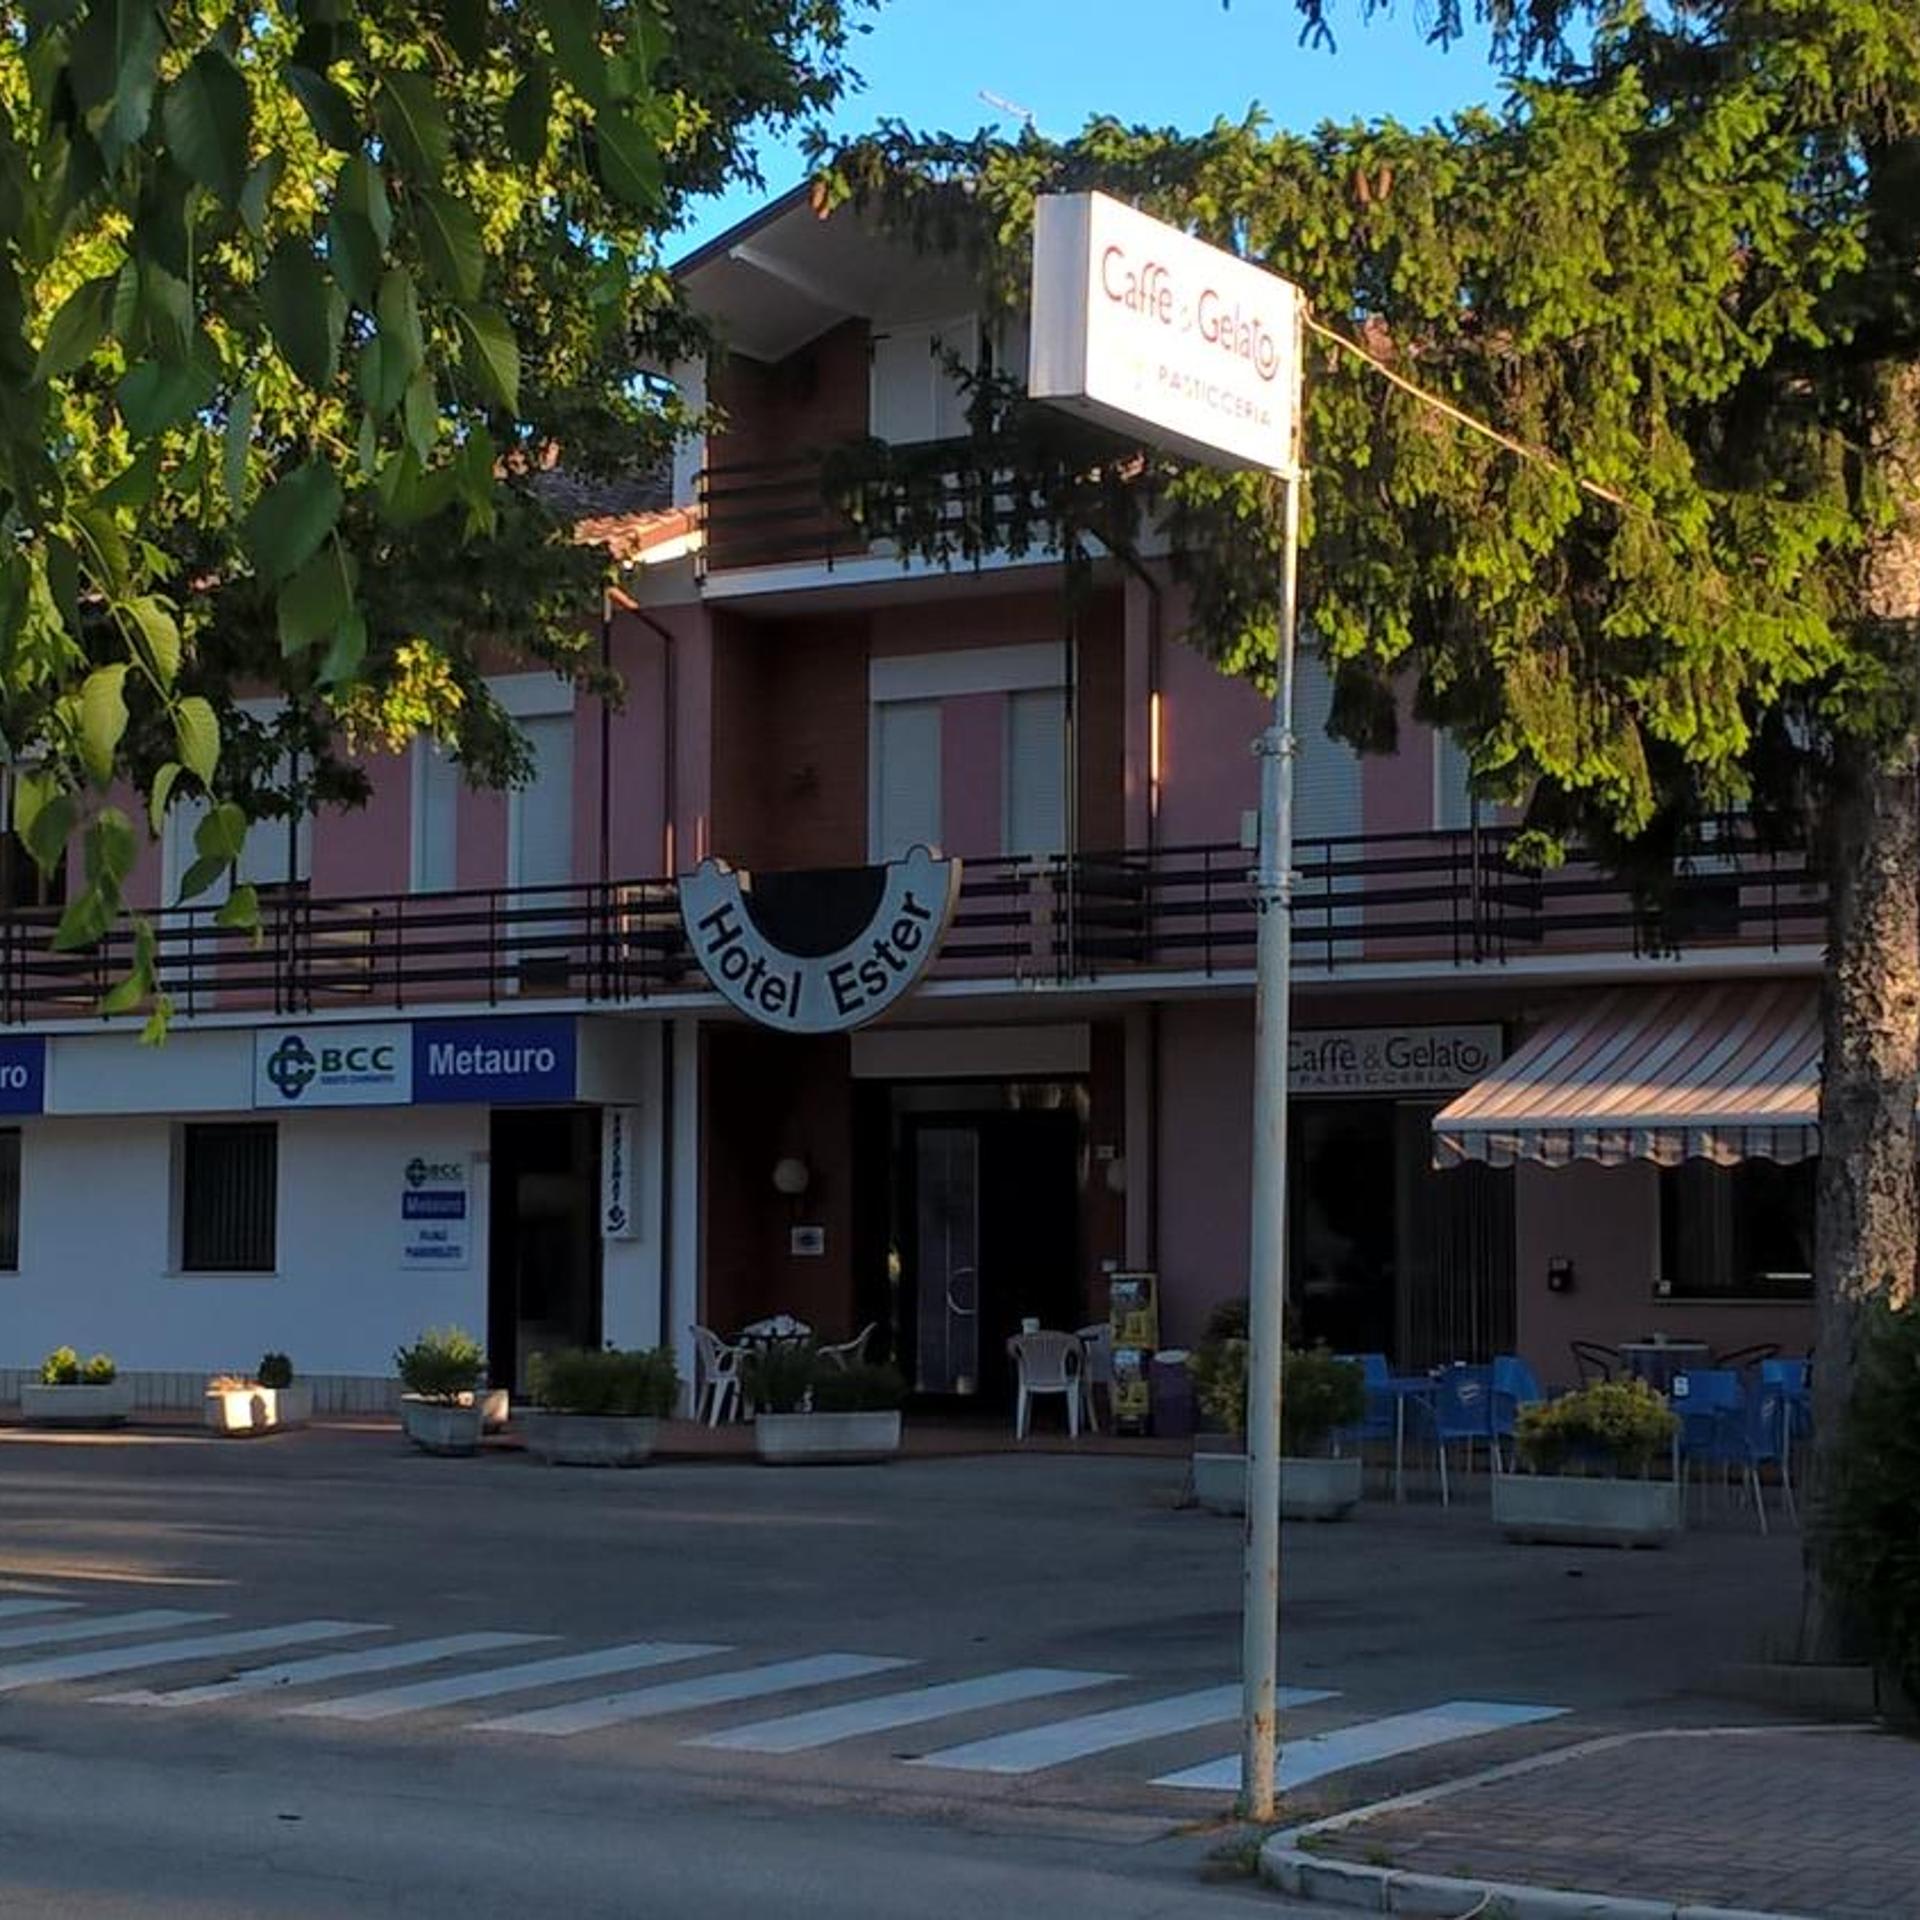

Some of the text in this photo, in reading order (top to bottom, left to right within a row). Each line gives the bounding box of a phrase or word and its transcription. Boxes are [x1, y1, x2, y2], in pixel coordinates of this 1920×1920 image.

[1199, 289, 1280, 382] Gelato
[698, 891, 932, 1018] Hotel Ester
[320, 1046, 395, 1073] BCC
[428, 1042, 556, 1077] Metauro
[1362, 1043, 1382, 1070] &
[1384, 1037, 1489, 1075] Gelato
[0, 1064, 28, 1089] ro
